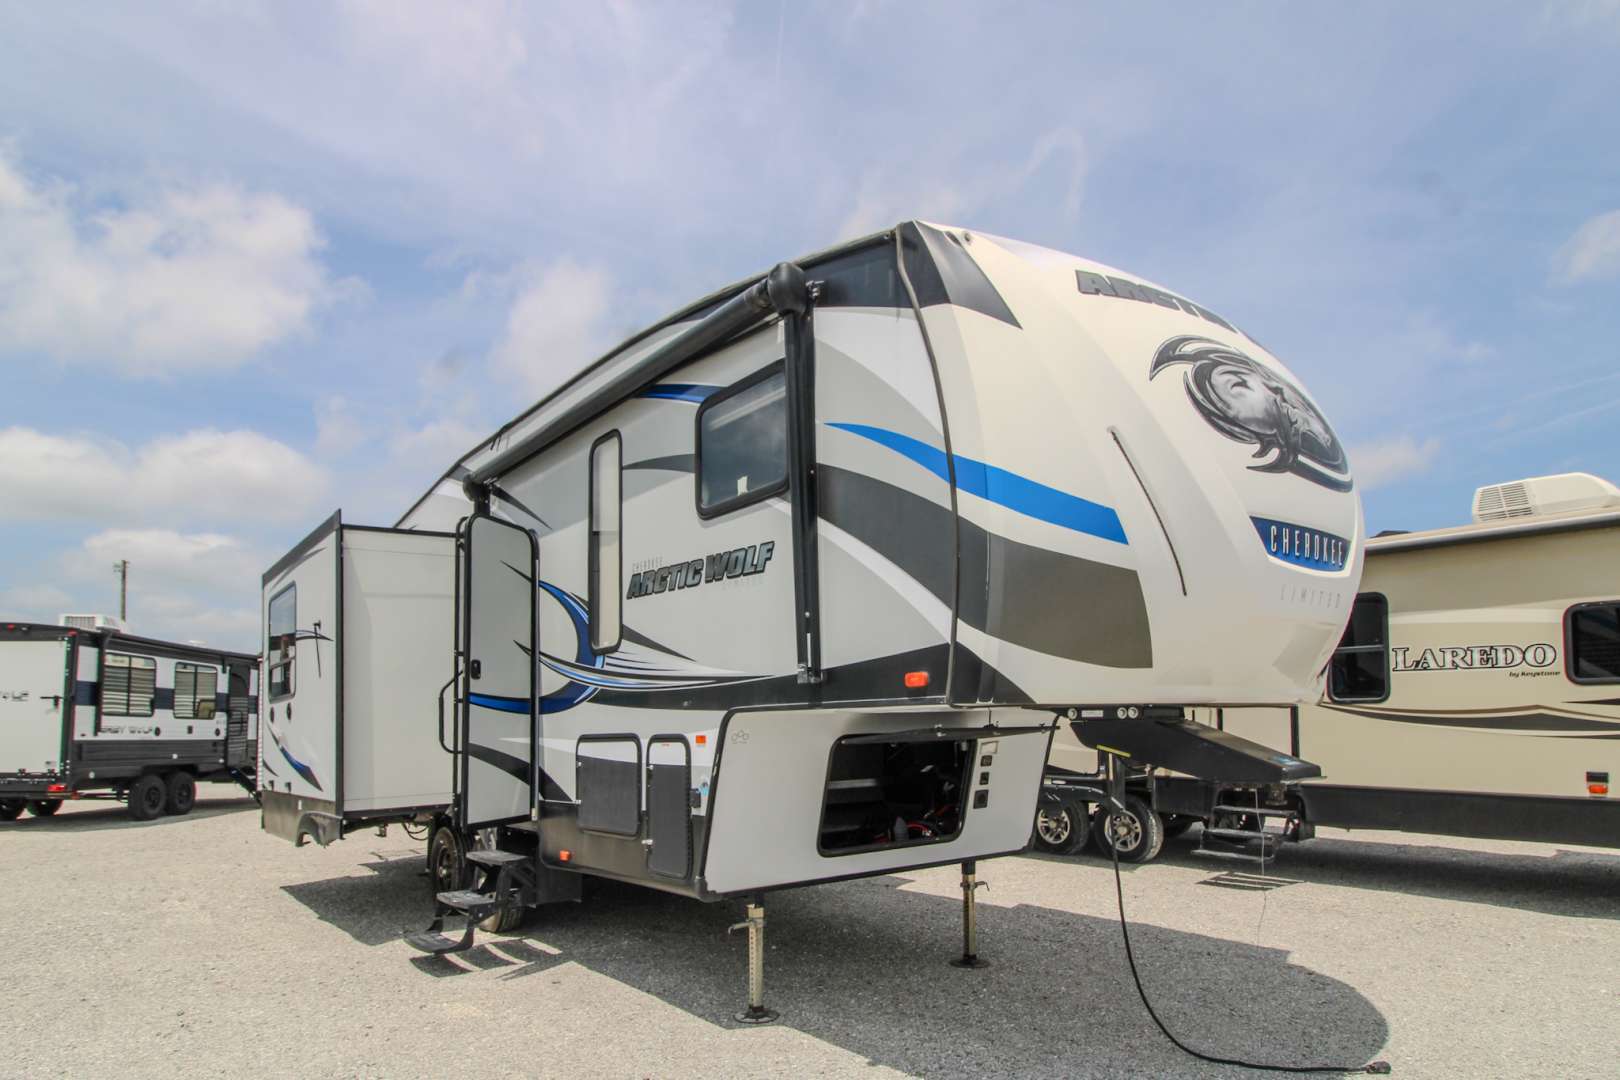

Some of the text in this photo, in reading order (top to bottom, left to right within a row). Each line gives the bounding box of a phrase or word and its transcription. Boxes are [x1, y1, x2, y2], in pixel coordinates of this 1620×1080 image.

[1270, 525, 1342, 567] CHEROKEE
[626, 540, 775, 600] ARCTIC WOLF
[1392, 643, 1557, 672] LAREDO
